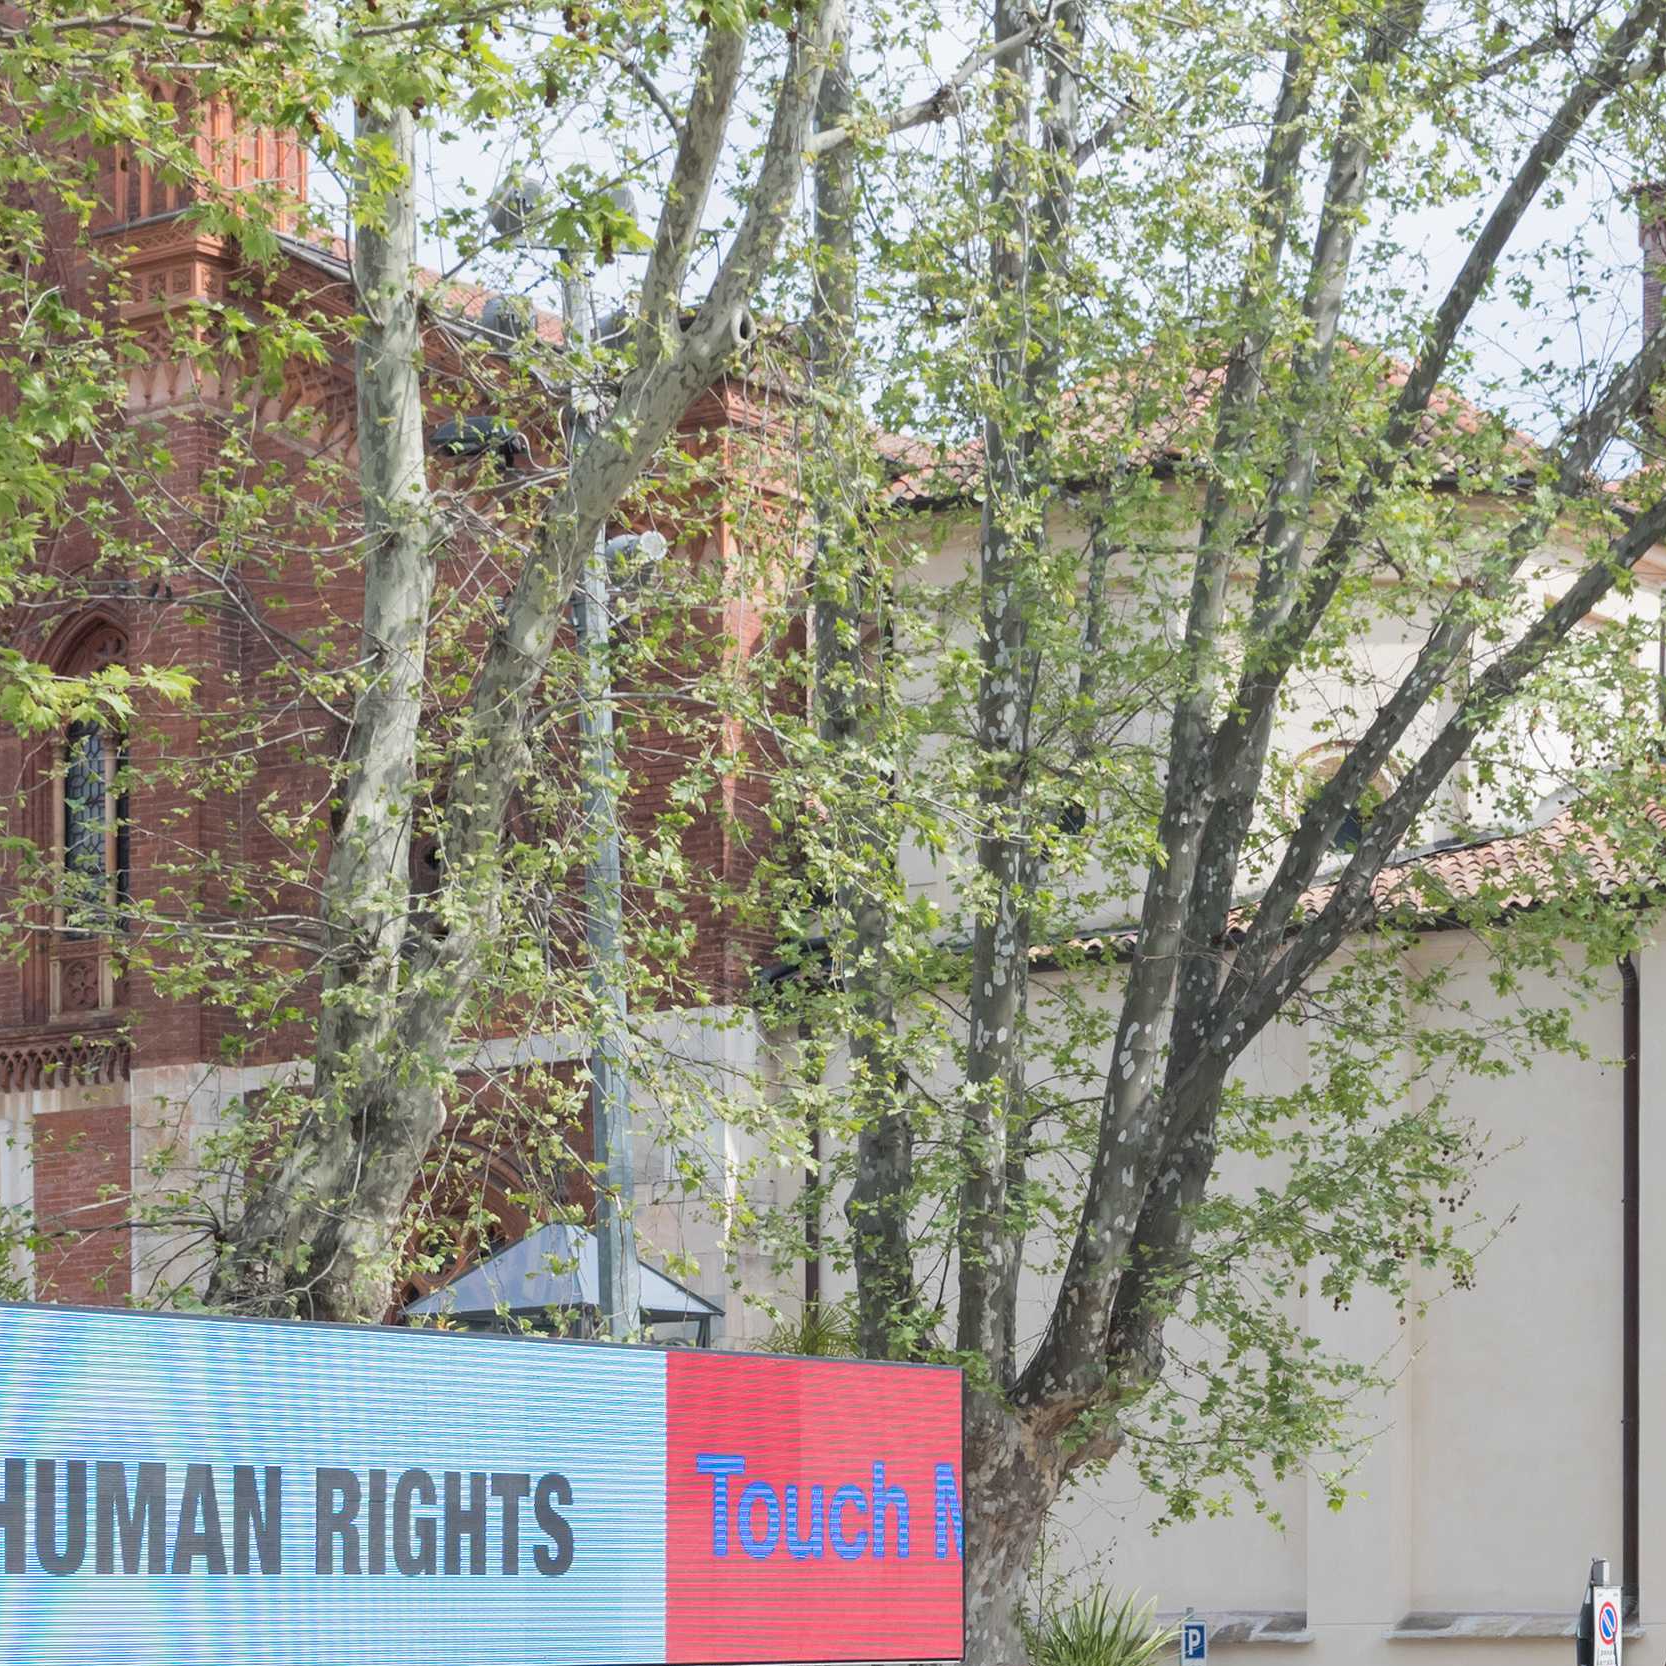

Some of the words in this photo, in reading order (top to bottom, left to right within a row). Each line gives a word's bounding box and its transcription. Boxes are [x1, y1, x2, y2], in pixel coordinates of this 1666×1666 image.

[315, 1466, 575, 1578] RIGHTS
[696, 1453, 911, 1560] Touch
[1188, 1628, 1201, 1656] P
